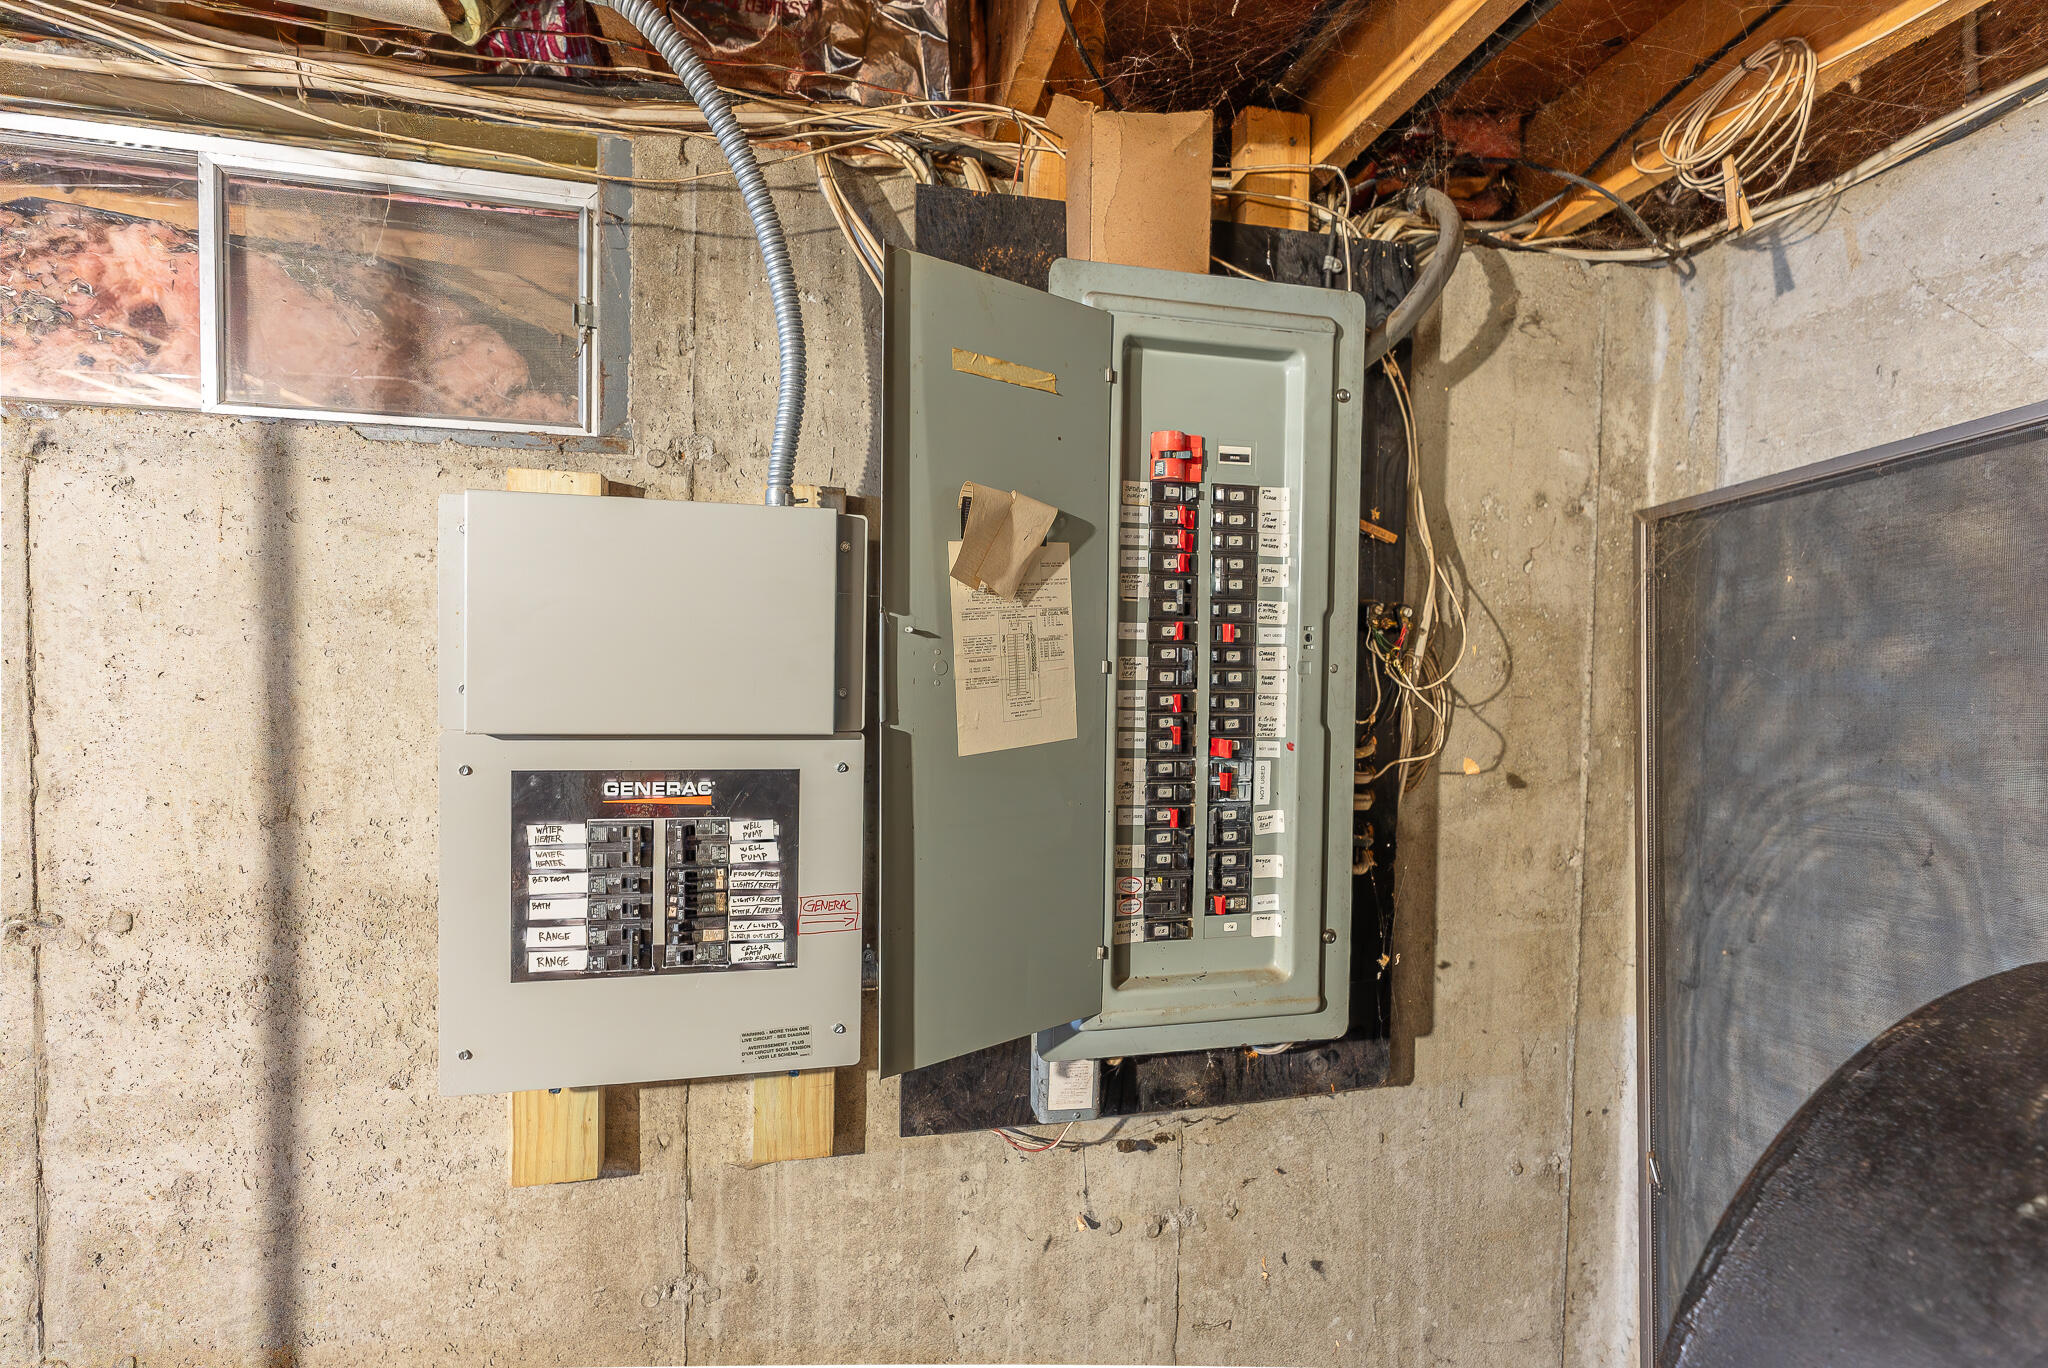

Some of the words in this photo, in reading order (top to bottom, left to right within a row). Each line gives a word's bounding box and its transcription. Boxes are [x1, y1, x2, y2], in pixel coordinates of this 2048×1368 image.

[603, 781, 713, 796] GENERAC
[535, 825, 565, 834] WATER
[742, 821, 762, 831] WELL
[534, 834, 563, 844] HEATER
[742, 830, 764, 840] PUMP
[740, 844, 764, 853] WELL
[535, 850, 565, 859] WATER
[740, 852, 768, 862] PUMP
[535, 859, 566, 868] HEATER
[531, 874, 570, 884] BEDROOM
[531, 901, 552, 910] BATH
[802, 899, 854, 913] GENERAC
[538, 931, 571, 942] RANGE
[741, 943, 771, 952] CELLAR
[536, 955, 570, 968] RANGE
[748, 1041, 788, 1051] AVERTISSEMENT
